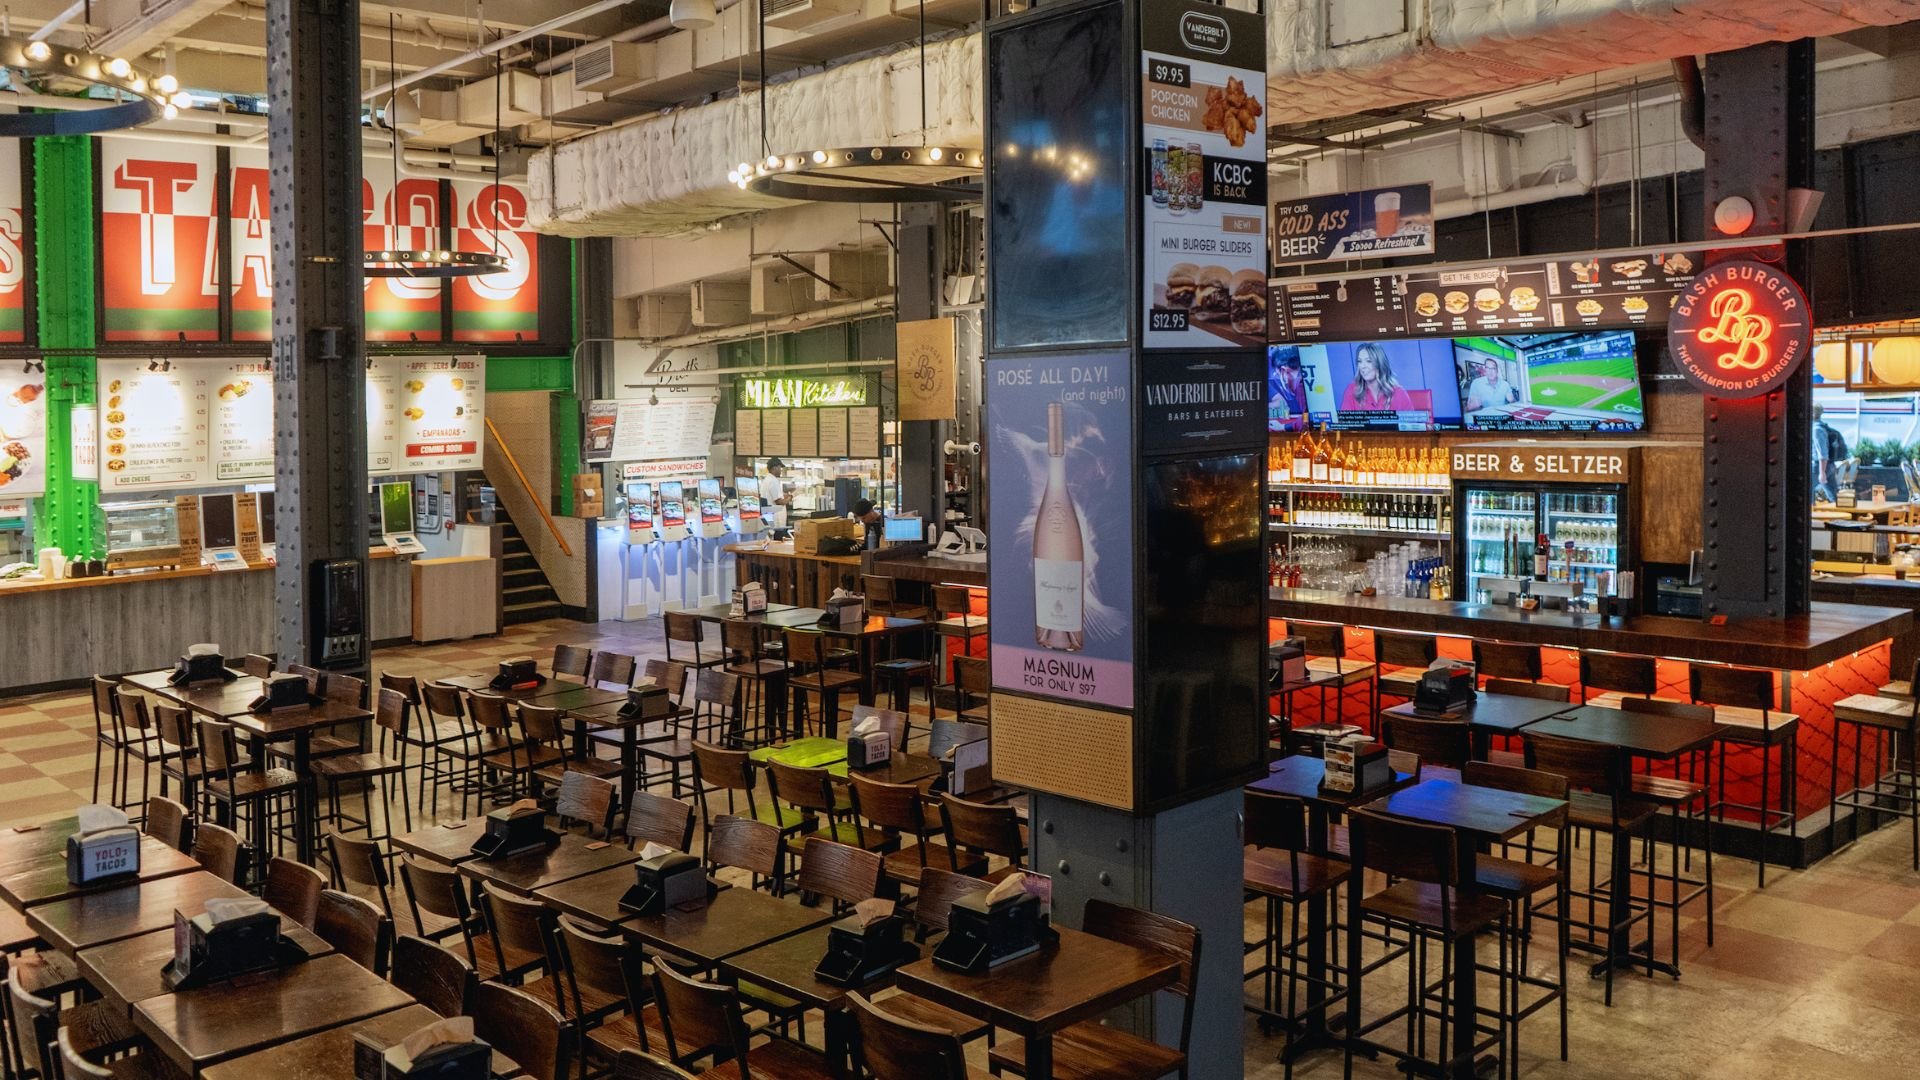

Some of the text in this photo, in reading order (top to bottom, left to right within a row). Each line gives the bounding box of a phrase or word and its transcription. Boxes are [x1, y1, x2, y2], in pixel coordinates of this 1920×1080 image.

[1186, 22, 1224, 38] VANDERBILT
[1156, 65, 1184, 83] $9.95
[1151, 89, 1198, 108] POPCORN
[1151, 104, 1191, 122] CHICKEN
[1214, 162, 1252, 186] KCBC
[1214, 184, 1247, 199] IS BACK
[1280, 204, 1308, 215] TRY OUR
[115, 159, 531, 300] TAOS
[1279, 209, 1350, 236] COLD ASS
[1161, 238, 1252, 254] MINI BURGER SLIDERS
[1280, 236, 1319, 257] BEER
[1374, 236, 1420, 250] Refreshing!
[1474, 270, 1500, 279] BURGE
[1677, 266, 1797, 317] BASH BURGER
[1153, 314, 1185, 329] $12.95
[1676, 339, 1799, 390] THE CHAMPION OF BURGERS
[998, 364, 1108, 386] ROSÉ ALL DAY!
[745, 379, 803, 408] MIAN
[1061, 386, 1126, 404] (and night!)
[1146, 381, 1262, 406] VANDERBILT MARKET
[1168, 412, 1190, 421] BARS
[1204, 409, 1244, 418] EATERIES
[626, 462, 704, 474] CUSTOM SANDWICHES
[1454, 453, 1623, 475] BEER & SELTZER
[1024, 656, 1095, 682] MAGNUM
[1024, 674, 1044, 688] FOR
[1048, 678, 1075, 693] ONLY
[95, 858, 127, 872] TACOS
